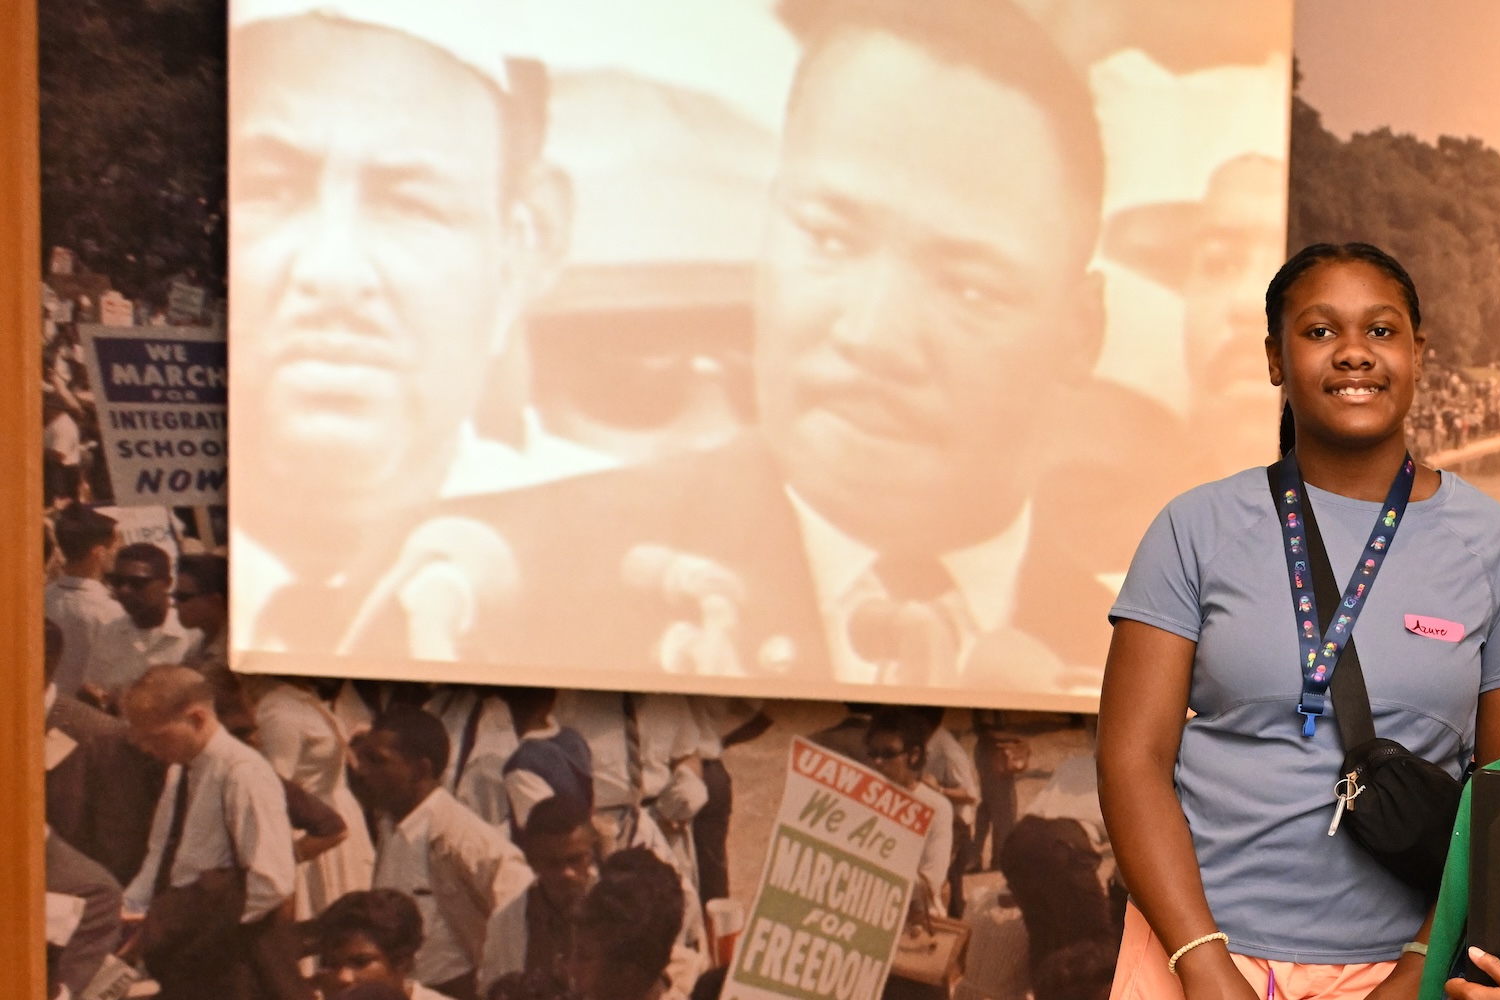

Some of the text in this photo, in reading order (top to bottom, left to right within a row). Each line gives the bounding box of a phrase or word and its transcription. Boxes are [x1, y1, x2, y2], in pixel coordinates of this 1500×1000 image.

[145, 343, 188, 362] WE
[111, 362, 228, 388] MARCH
[109, 410, 228, 430] INTEGRAT
[117, 440, 228, 458] SCHOO
[1411, 619, 1448, 637] Azure
[797, 749, 932, 833] UAW SAYS:
[798, 788, 898, 860] We Are
[768, 834, 904, 932] MARCHING
[801, 907, 858, 941] FOR
